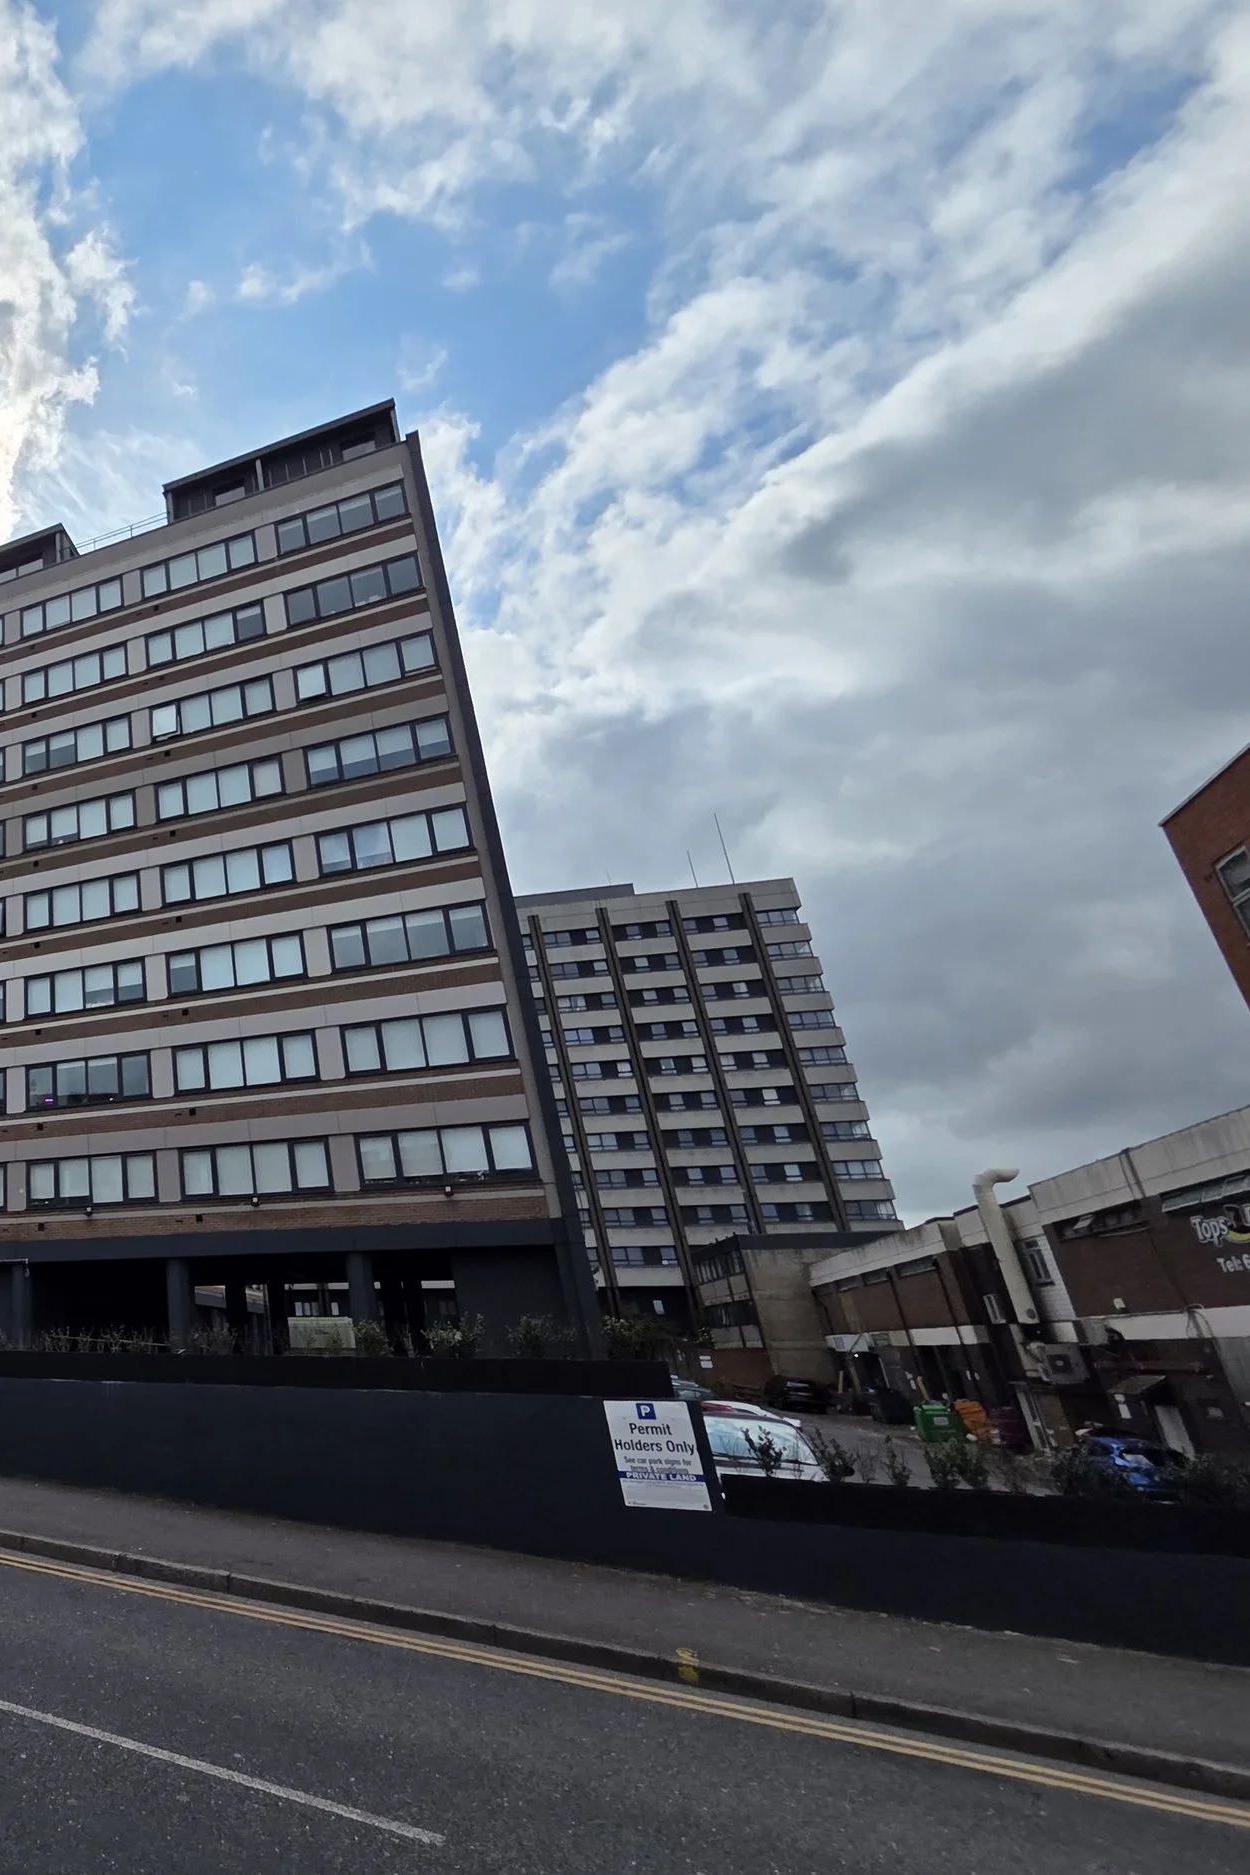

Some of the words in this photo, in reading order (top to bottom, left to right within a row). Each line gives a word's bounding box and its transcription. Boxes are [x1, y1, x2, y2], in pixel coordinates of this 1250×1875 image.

[1190, 1215, 1228, 1247] Tops
[639, 1405, 651, 1417] P
[629, 1423, 673, 1436] Permit
[614, 1439, 663, 1452] Holders
[666, 1440, 695, 1456] Only
[623, 1456, 636, 1464] See
[648, 1457, 663, 1466] park
[664, 1458, 681, 1467] signs
[682, 1458, 692, 1466] for
[626, 1471, 667, 1480] PRIVATE
[669, 1472, 697, 1481] LAND
